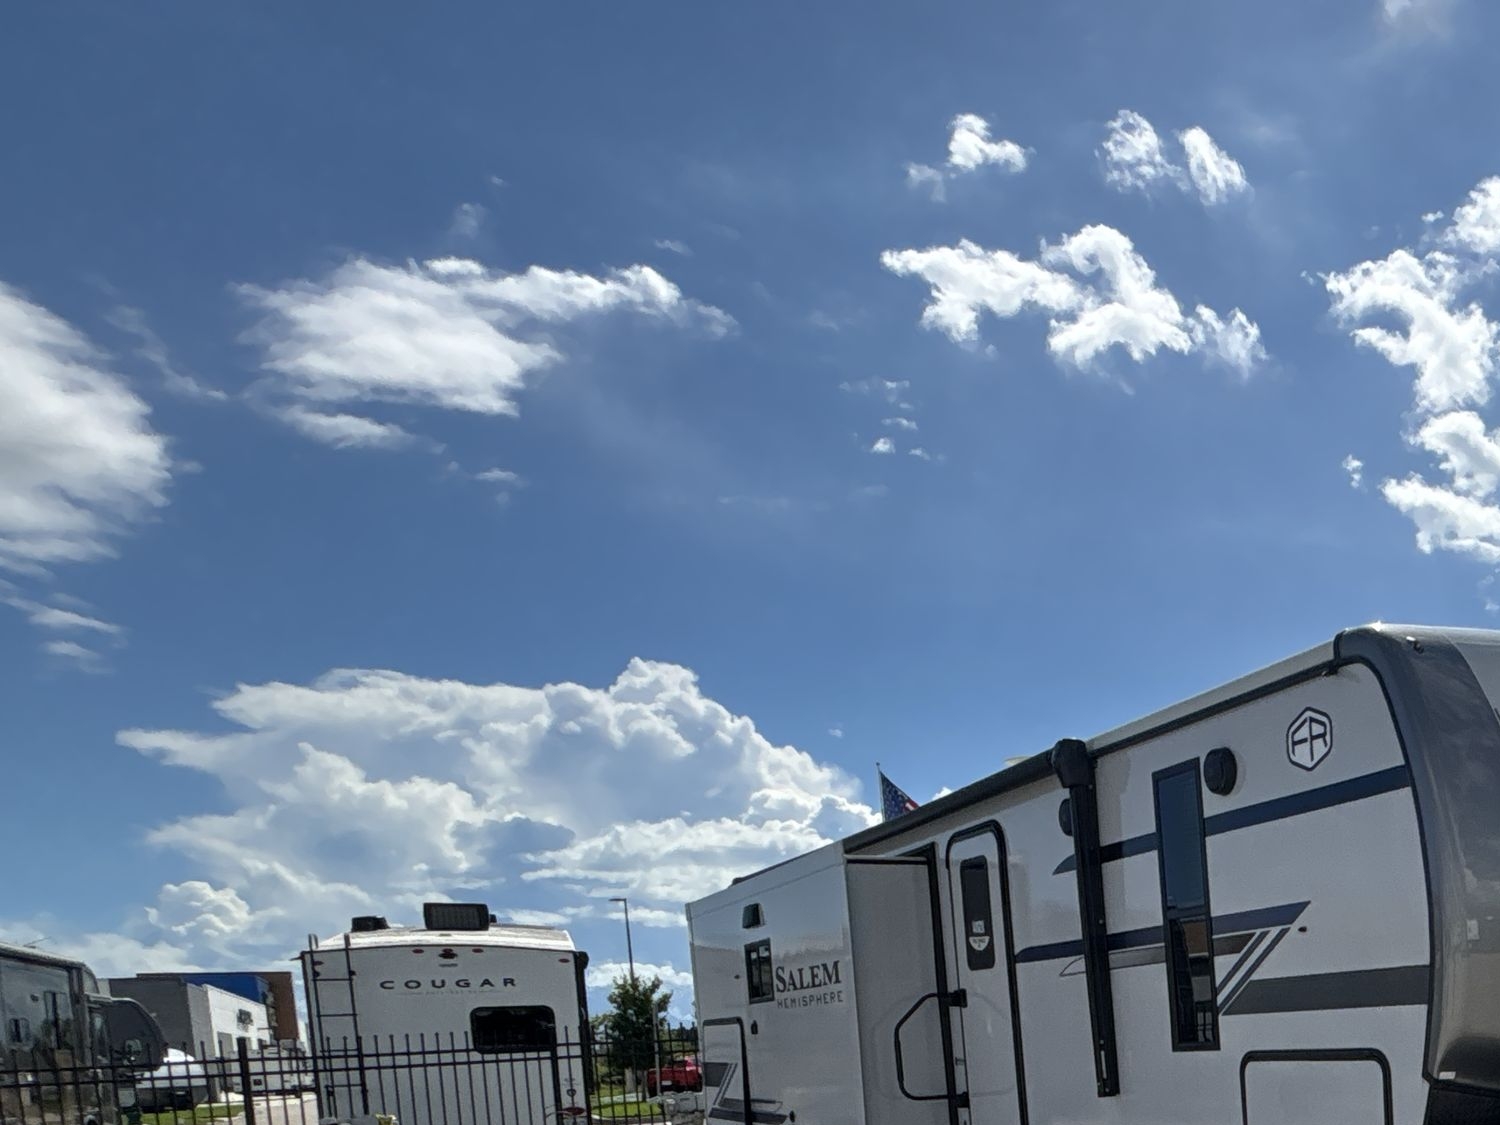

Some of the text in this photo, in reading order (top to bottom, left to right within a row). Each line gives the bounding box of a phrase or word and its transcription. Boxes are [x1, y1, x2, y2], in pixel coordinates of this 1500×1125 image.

[379, 977, 516, 990] COUGAR
[775, 960, 842, 993] SALEM
[776, 990, 844, 1009] HEMISPHERE
